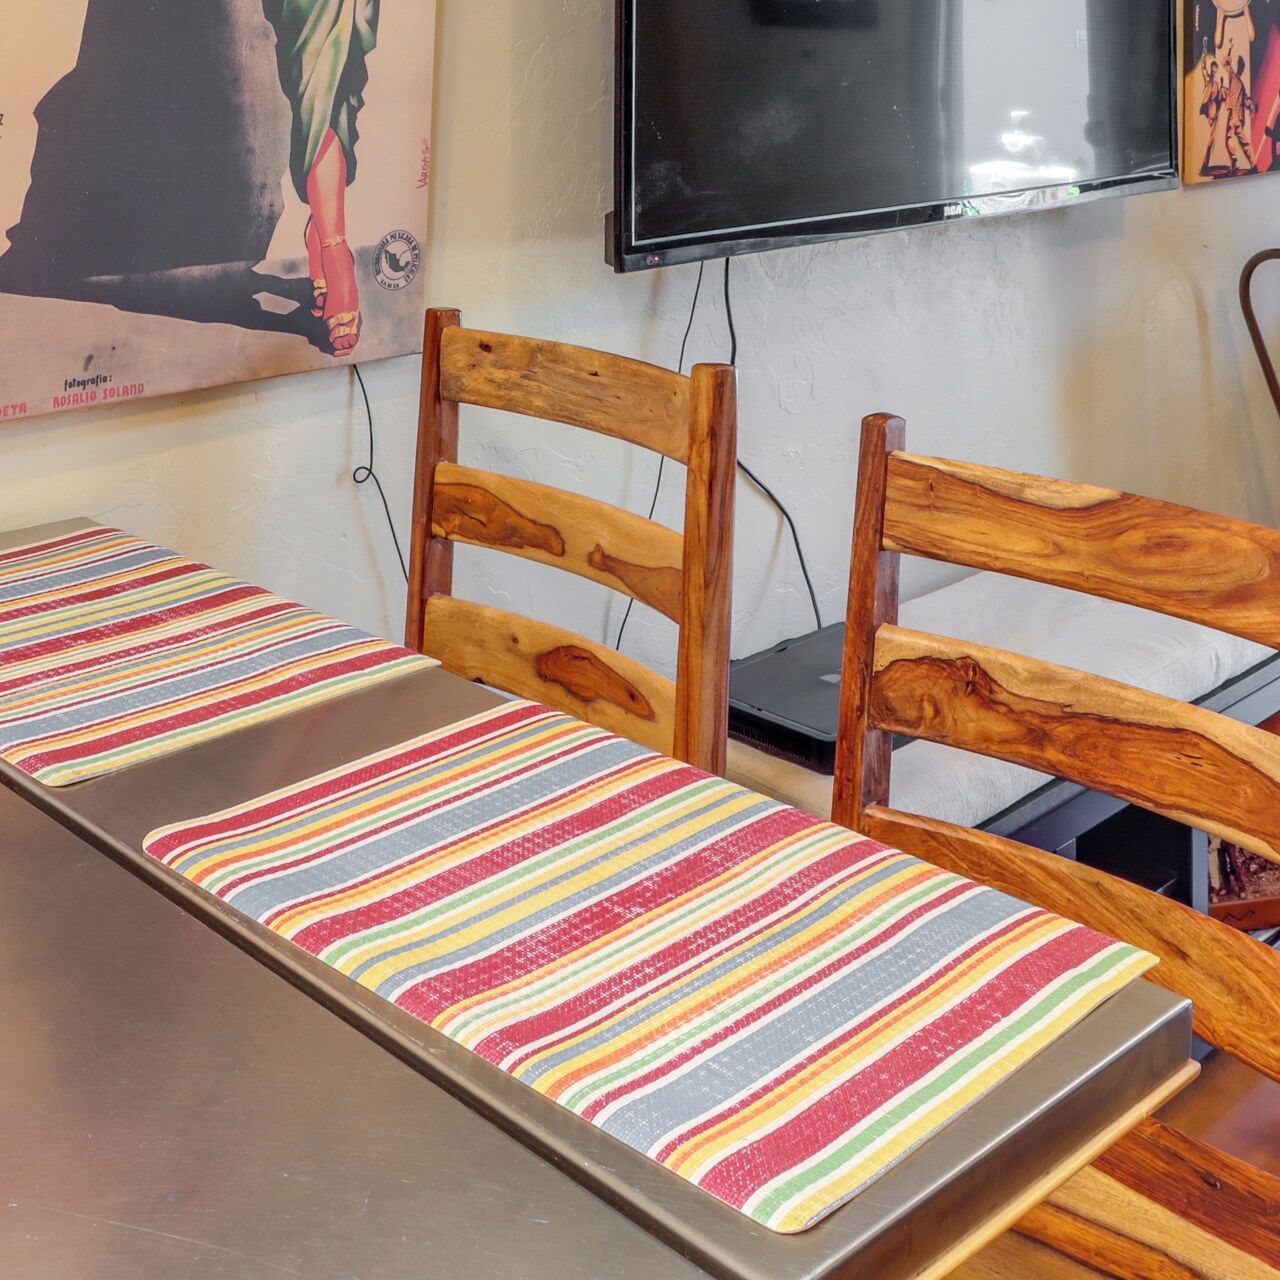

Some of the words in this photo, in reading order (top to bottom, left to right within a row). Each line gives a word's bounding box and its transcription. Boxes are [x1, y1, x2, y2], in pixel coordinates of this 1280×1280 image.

[943, 205, 961, 216] RCA
[53, 391, 97, 408] ROSALIO
[103, 383, 144, 400] SOLANO
